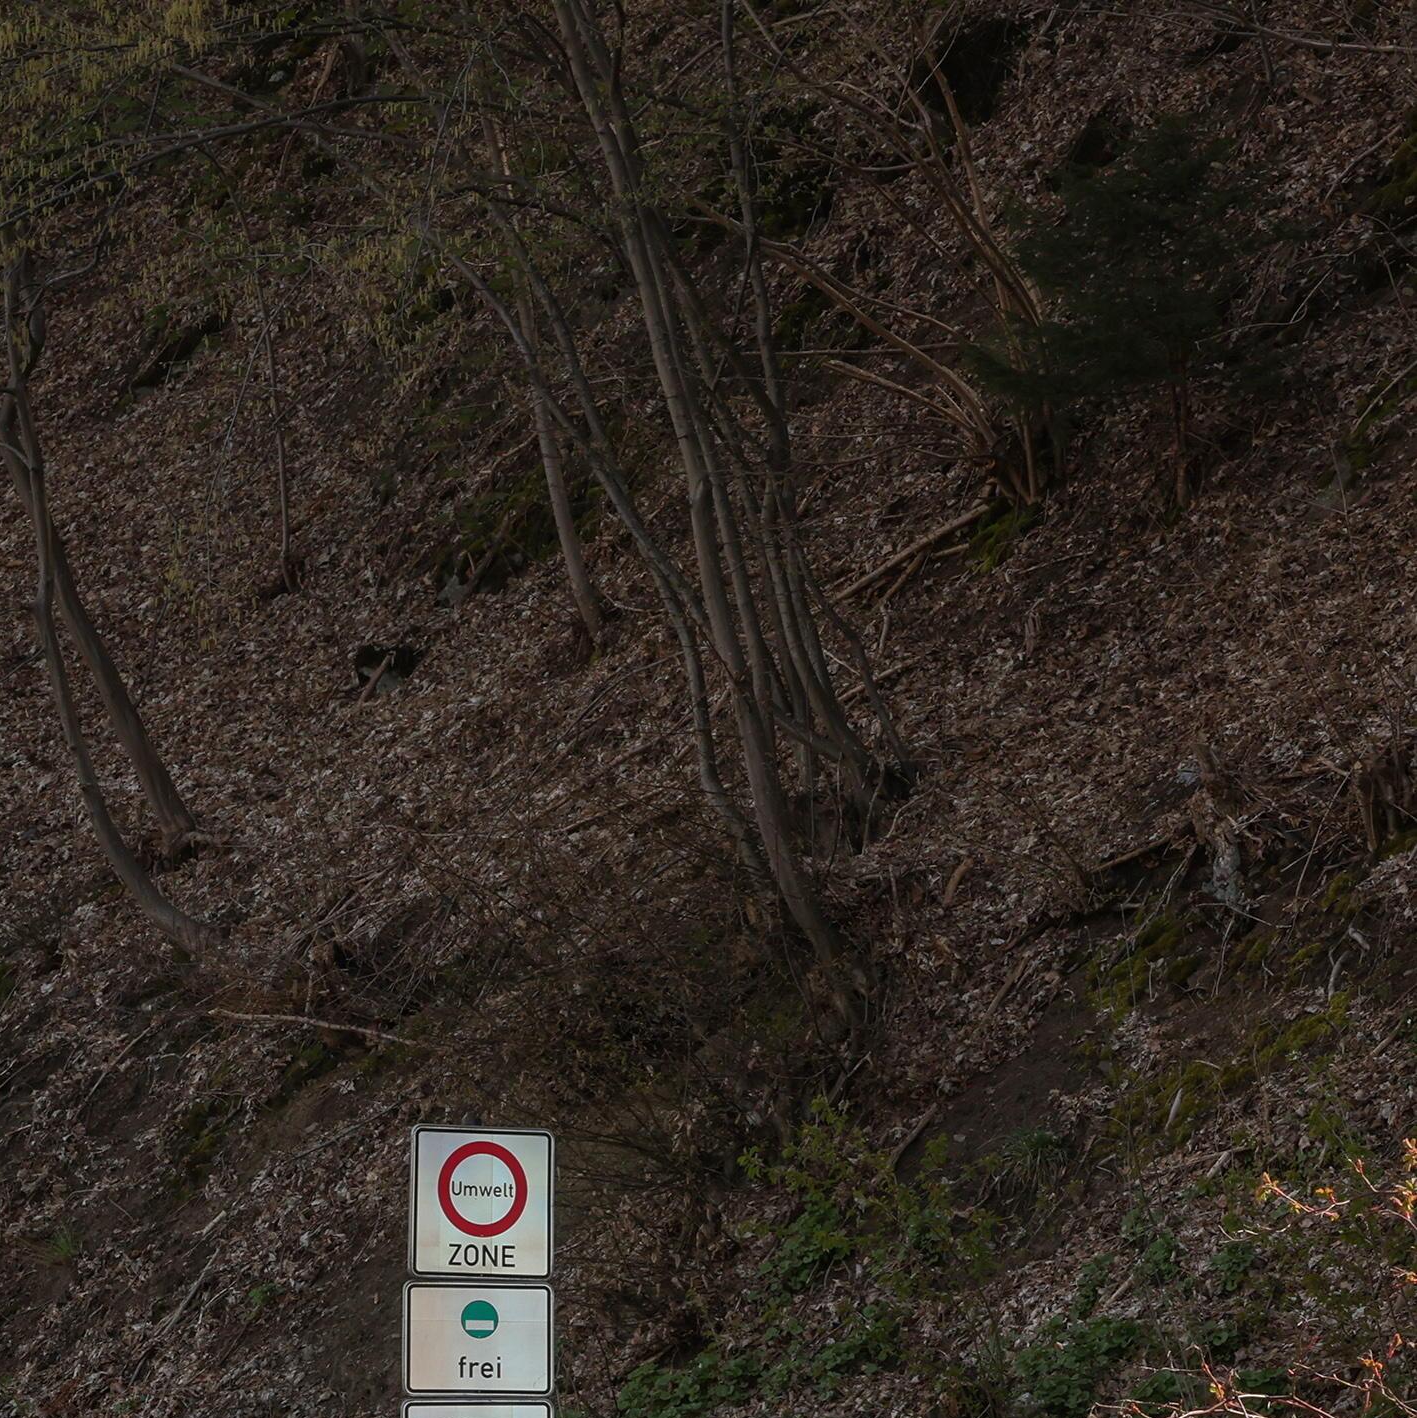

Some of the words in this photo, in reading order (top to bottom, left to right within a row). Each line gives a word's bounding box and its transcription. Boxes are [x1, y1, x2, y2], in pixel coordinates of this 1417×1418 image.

[451, 1180, 514, 1199] Umwelt
[448, 1243, 516, 1268] ZONE
[458, 1356, 502, 1379] frei
